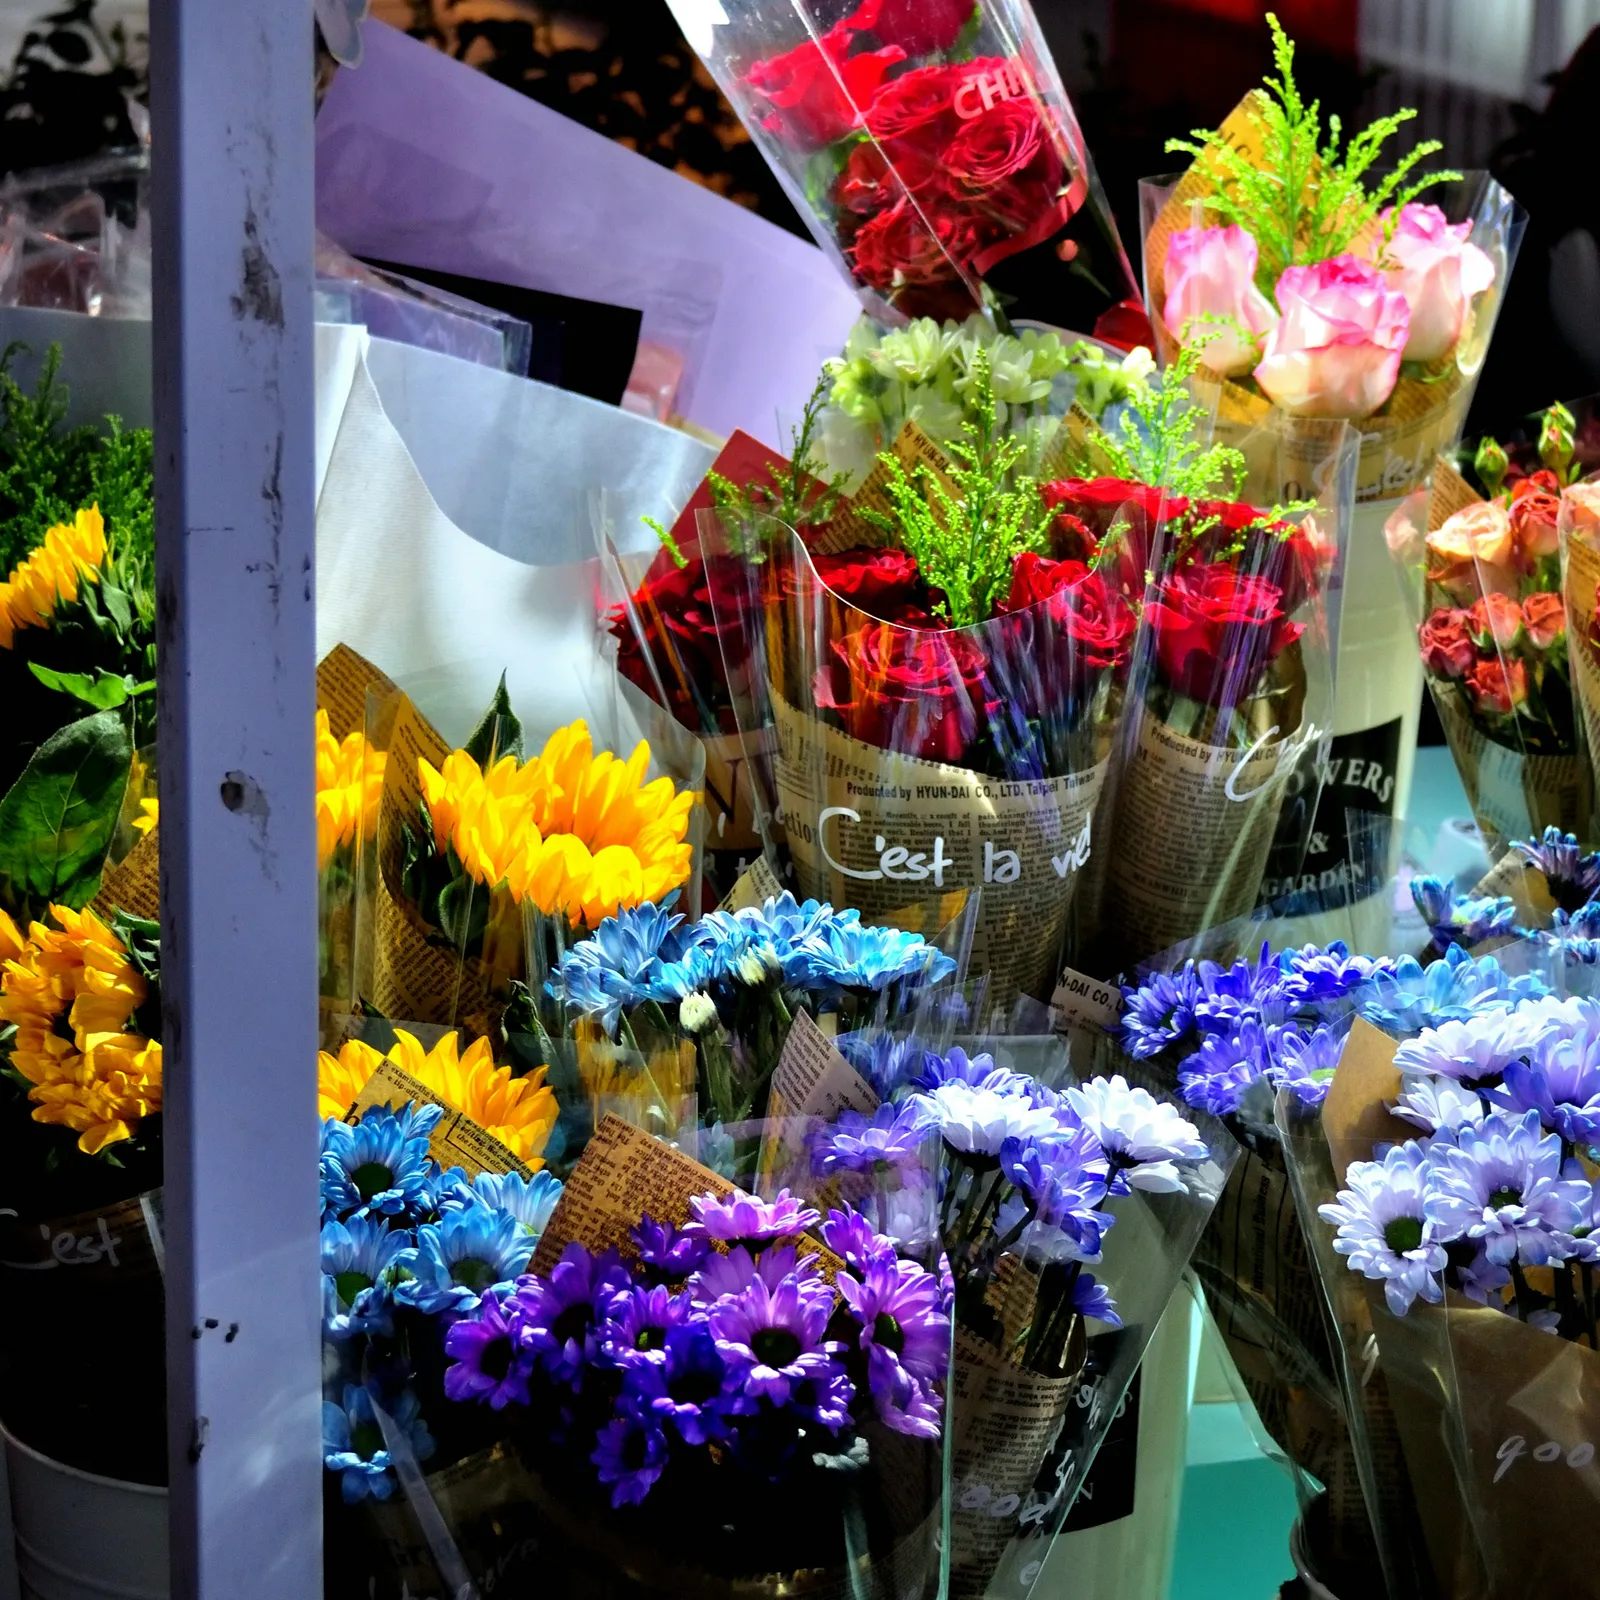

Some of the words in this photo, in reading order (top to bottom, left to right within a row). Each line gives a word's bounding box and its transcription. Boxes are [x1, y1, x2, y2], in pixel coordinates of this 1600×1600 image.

[847, 782, 897, 798] Producted
[900, 786, 911, 801] by
[917, 786, 970, 799] HYUN-DAI
[1001, 784, 1024, 797] LTD.
[1027, 779, 1059, 797] Taipei
[1064, 771, 1096, 790] Taiwan
[1283, 758, 1395, 803] OWERS
[818, 806, 953, 888] C'est
[984, 841, 1021, 883] la
[1309, 831, 1330, 855] &
